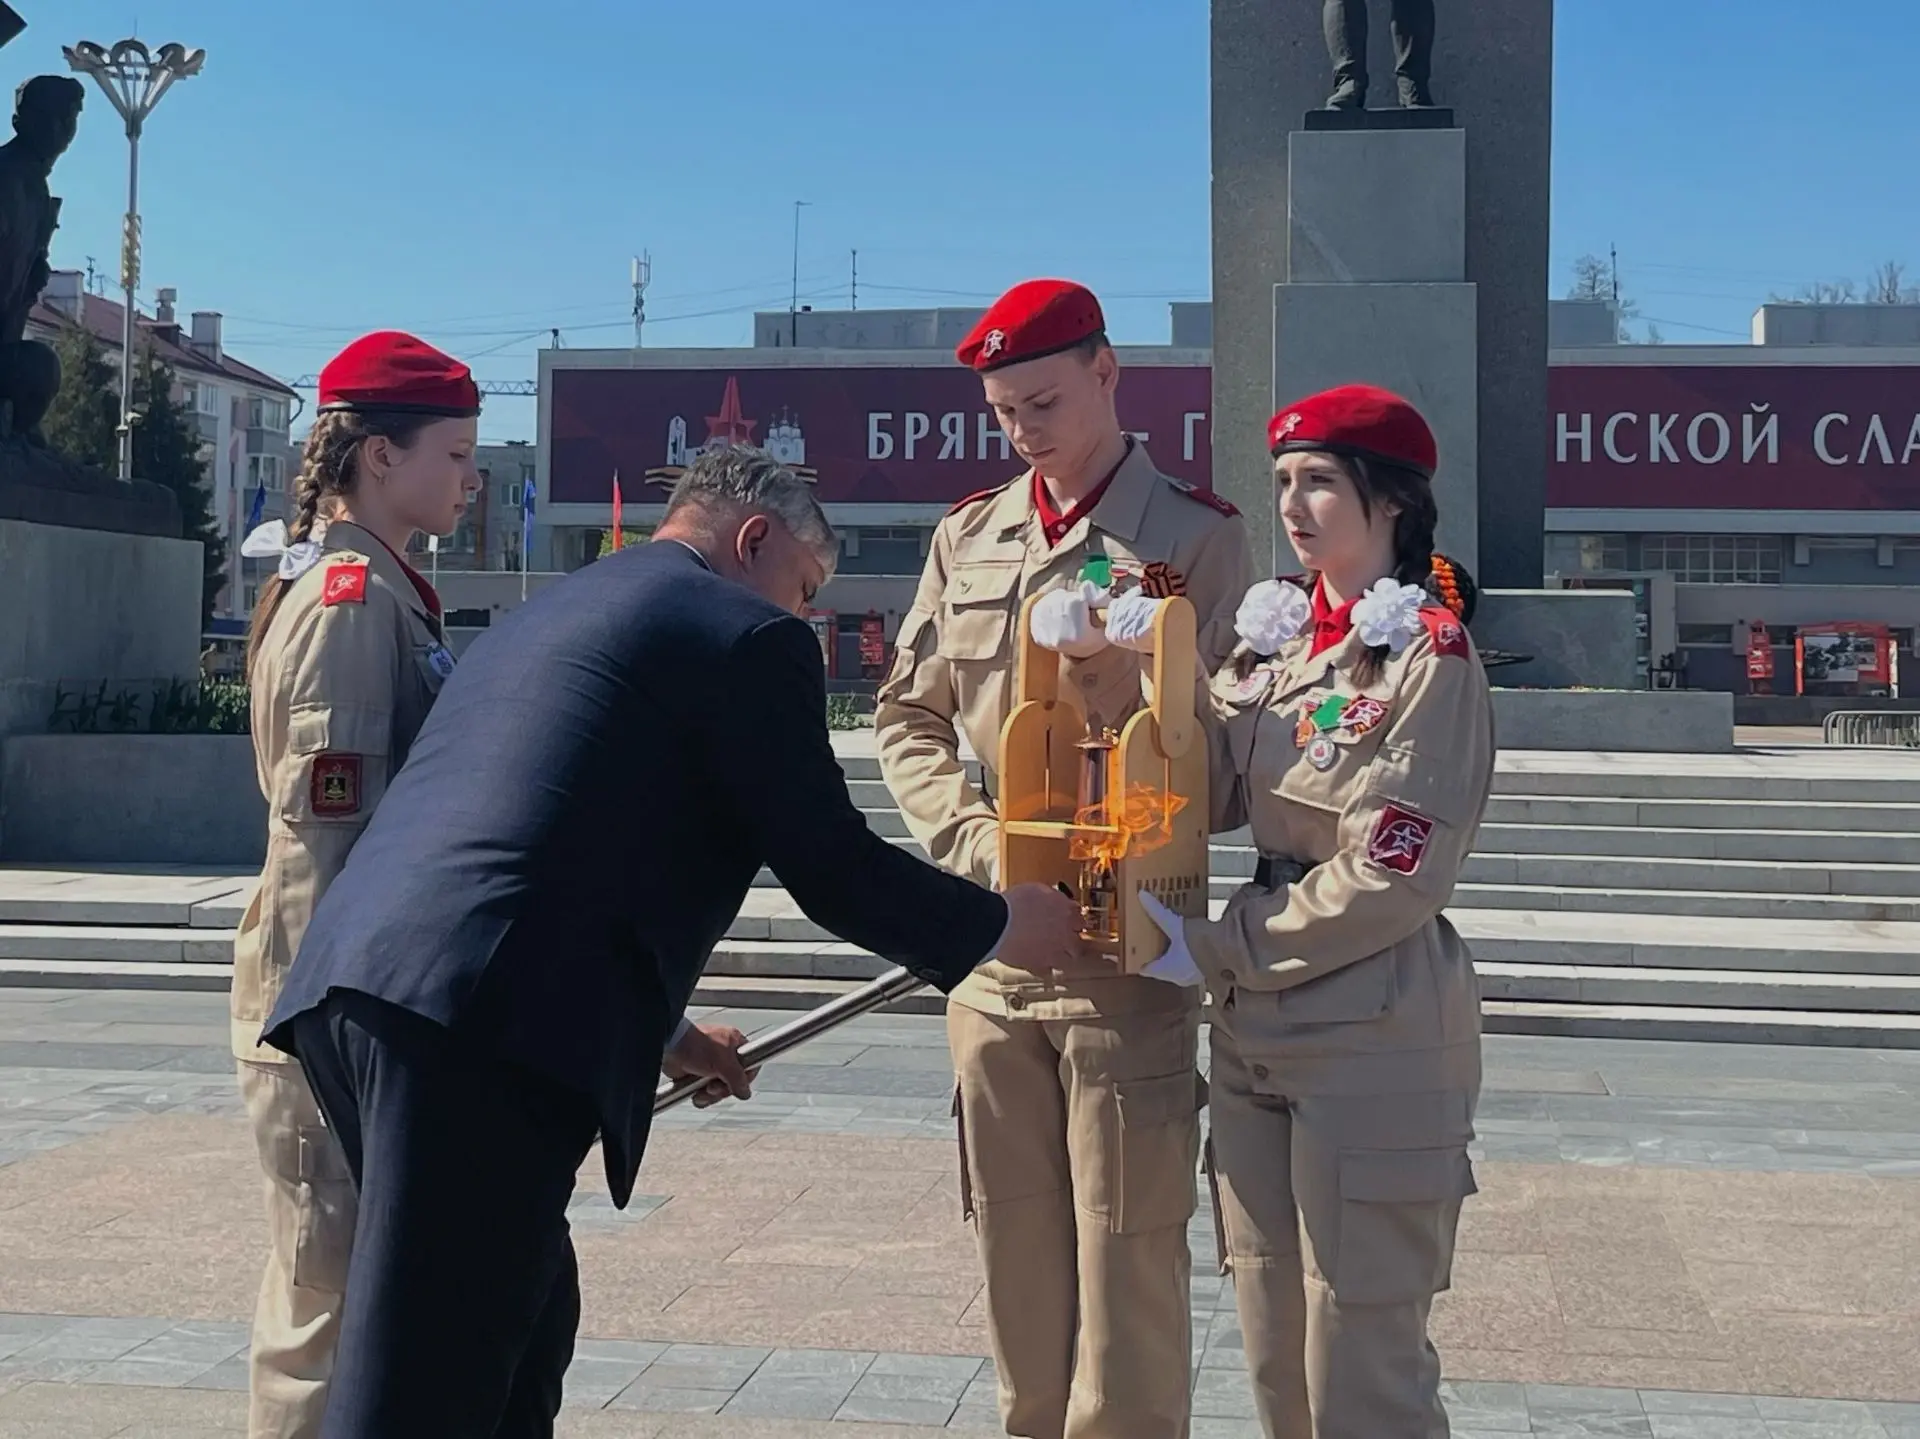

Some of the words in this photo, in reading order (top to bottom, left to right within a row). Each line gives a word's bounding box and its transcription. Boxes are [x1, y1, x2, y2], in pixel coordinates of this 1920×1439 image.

[867, 411, 1010, 460] БРЯН
[1555, 402, 1780, 465] НСКОЙ
[1813, 412, 1920, 466] СЛА
[1157, 891, 1188, 909] РОНТ
